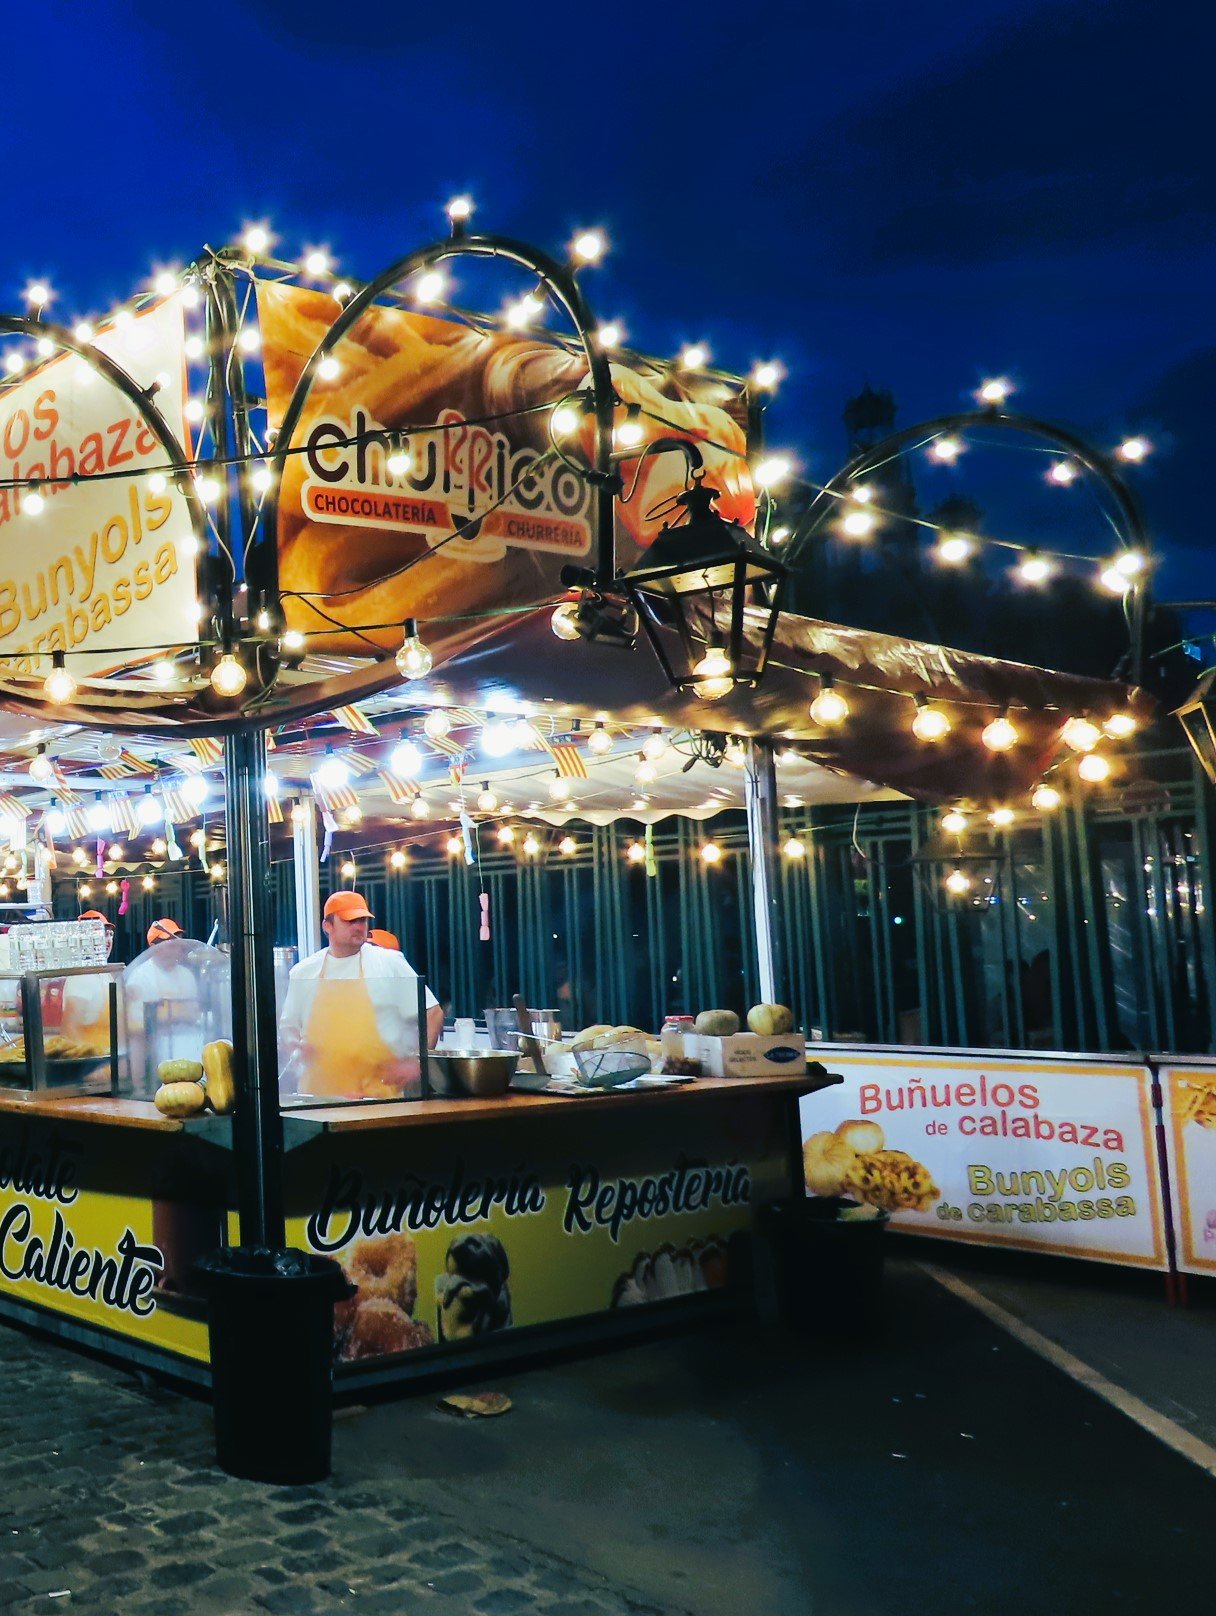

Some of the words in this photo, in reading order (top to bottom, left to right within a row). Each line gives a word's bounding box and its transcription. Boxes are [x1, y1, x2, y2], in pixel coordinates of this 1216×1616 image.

[314, 493, 438, 524] CHOCOLATERÍA
[859, 1075, 1040, 1115] Buñuelos
[925, 1120, 948, 1136] de
[958, 1110, 1125, 1153] calabaza
[967, 1158, 1131, 1202] Bunyols
[306, 1156, 546, 1253] Buñolería
[563, 1152, 752, 1243] Repostería
[936, 1202, 962, 1221] de
[967, 1196, 1136, 1224] carabassa
